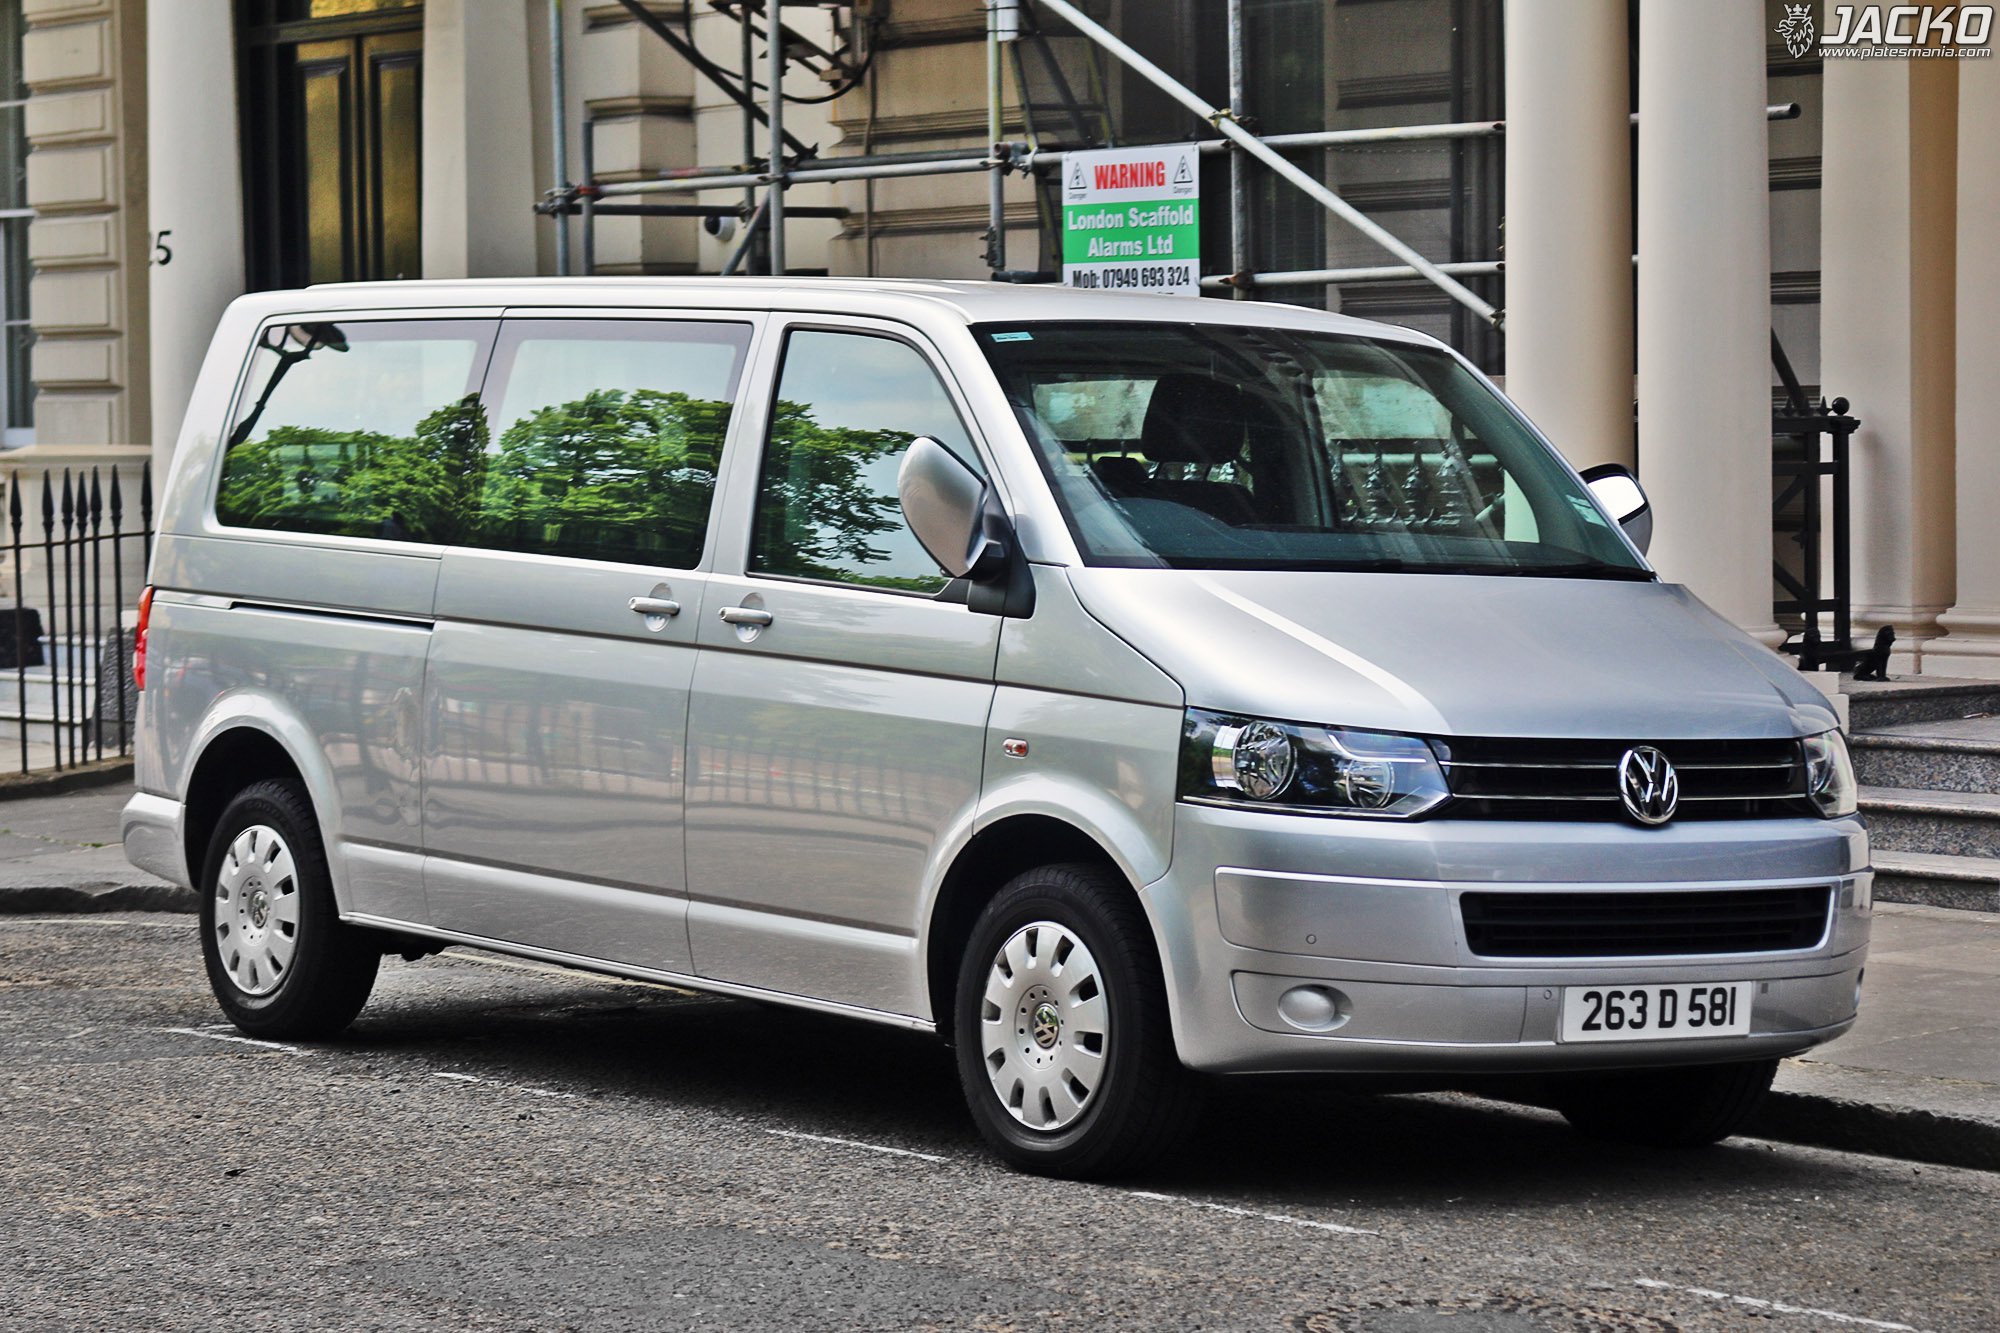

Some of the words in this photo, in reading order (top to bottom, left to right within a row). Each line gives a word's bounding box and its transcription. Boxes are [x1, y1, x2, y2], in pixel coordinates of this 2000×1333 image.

[1094, 161, 1166, 190] WARNING
[1068, 209, 1124, 231] London
[1128, 204, 1194, 228] Scaffold
[1087, 237, 1143, 258] Alarms
[1147, 233, 1174, 255] Ltd
[1072, 269, 1100, 289] Mob:
[1102, 268, 1138, 289] 07949
[1141, 267, 1164, 287] 693
[1167, 265, 1190, 286] 324
[1581, 989, 1649, 1031] 263
[1658, 988, 1678, 1029] D
[1688, 986, 1737, 1028] 581
